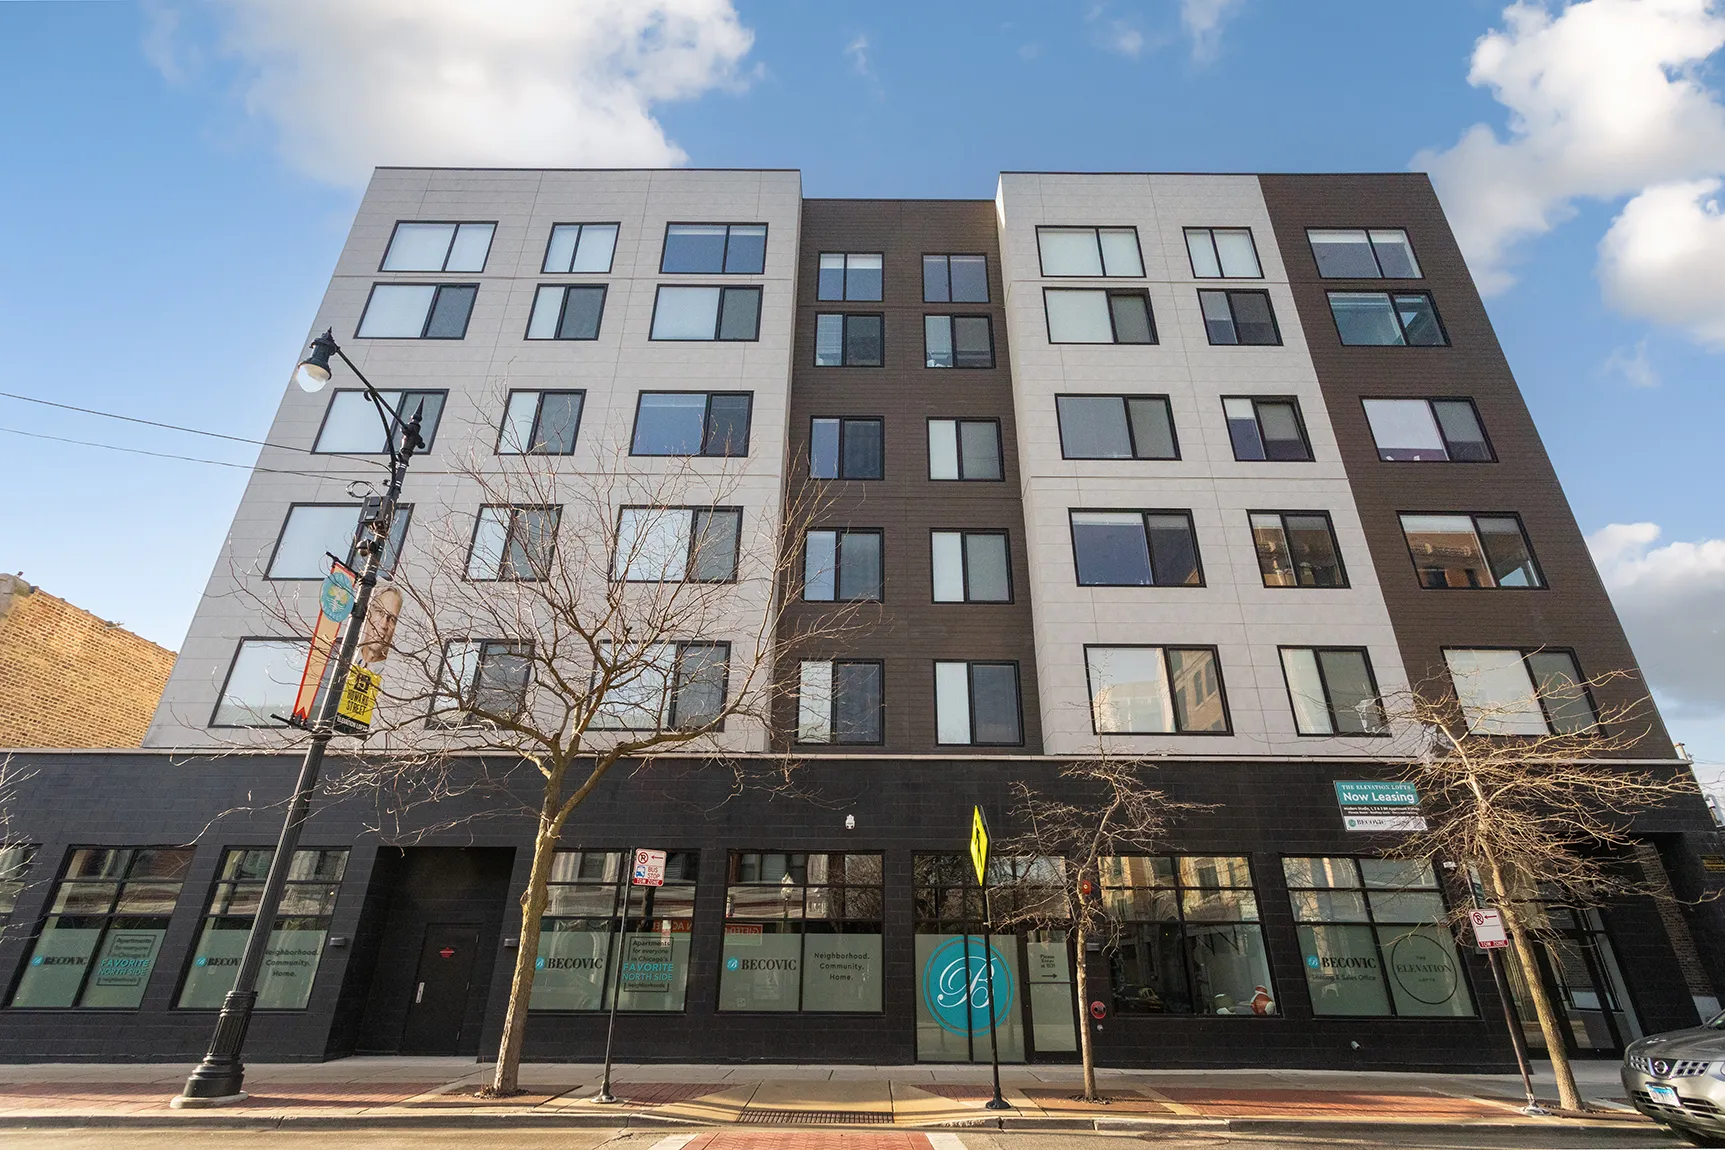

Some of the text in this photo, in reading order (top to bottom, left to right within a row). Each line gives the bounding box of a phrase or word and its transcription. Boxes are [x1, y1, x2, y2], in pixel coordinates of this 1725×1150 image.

[346, 700, 367, 716] STREET
[1343, 791, 1415, 804] Now Leasing
[638, 955, 668, 963] Chicago's
[814, 952, 870, 960] Neighborhood.
[43, 956, 88, 966] BECOVIC
[100, 959, 150, 967] FAVORITE
[207, 957, 242, 967] BECOV
[265, 959, 311, 967] Community.
[547, 957, 604, 970] BECOVIC
[741, 959, 797, 971] BECOVIC
[1321, 957, 1377, 969] BECOVIC
[623, 963, 674, 972] FAVORITE
[820, 962, 865, 971] Community.
[1396, 964, 1452, 973] ELEVATION
[97, 967, 148, 976] NORTH SIDE
[622, 973, 673, 981] NORTH SIDE
[829, 973, 854, 981] Home.
